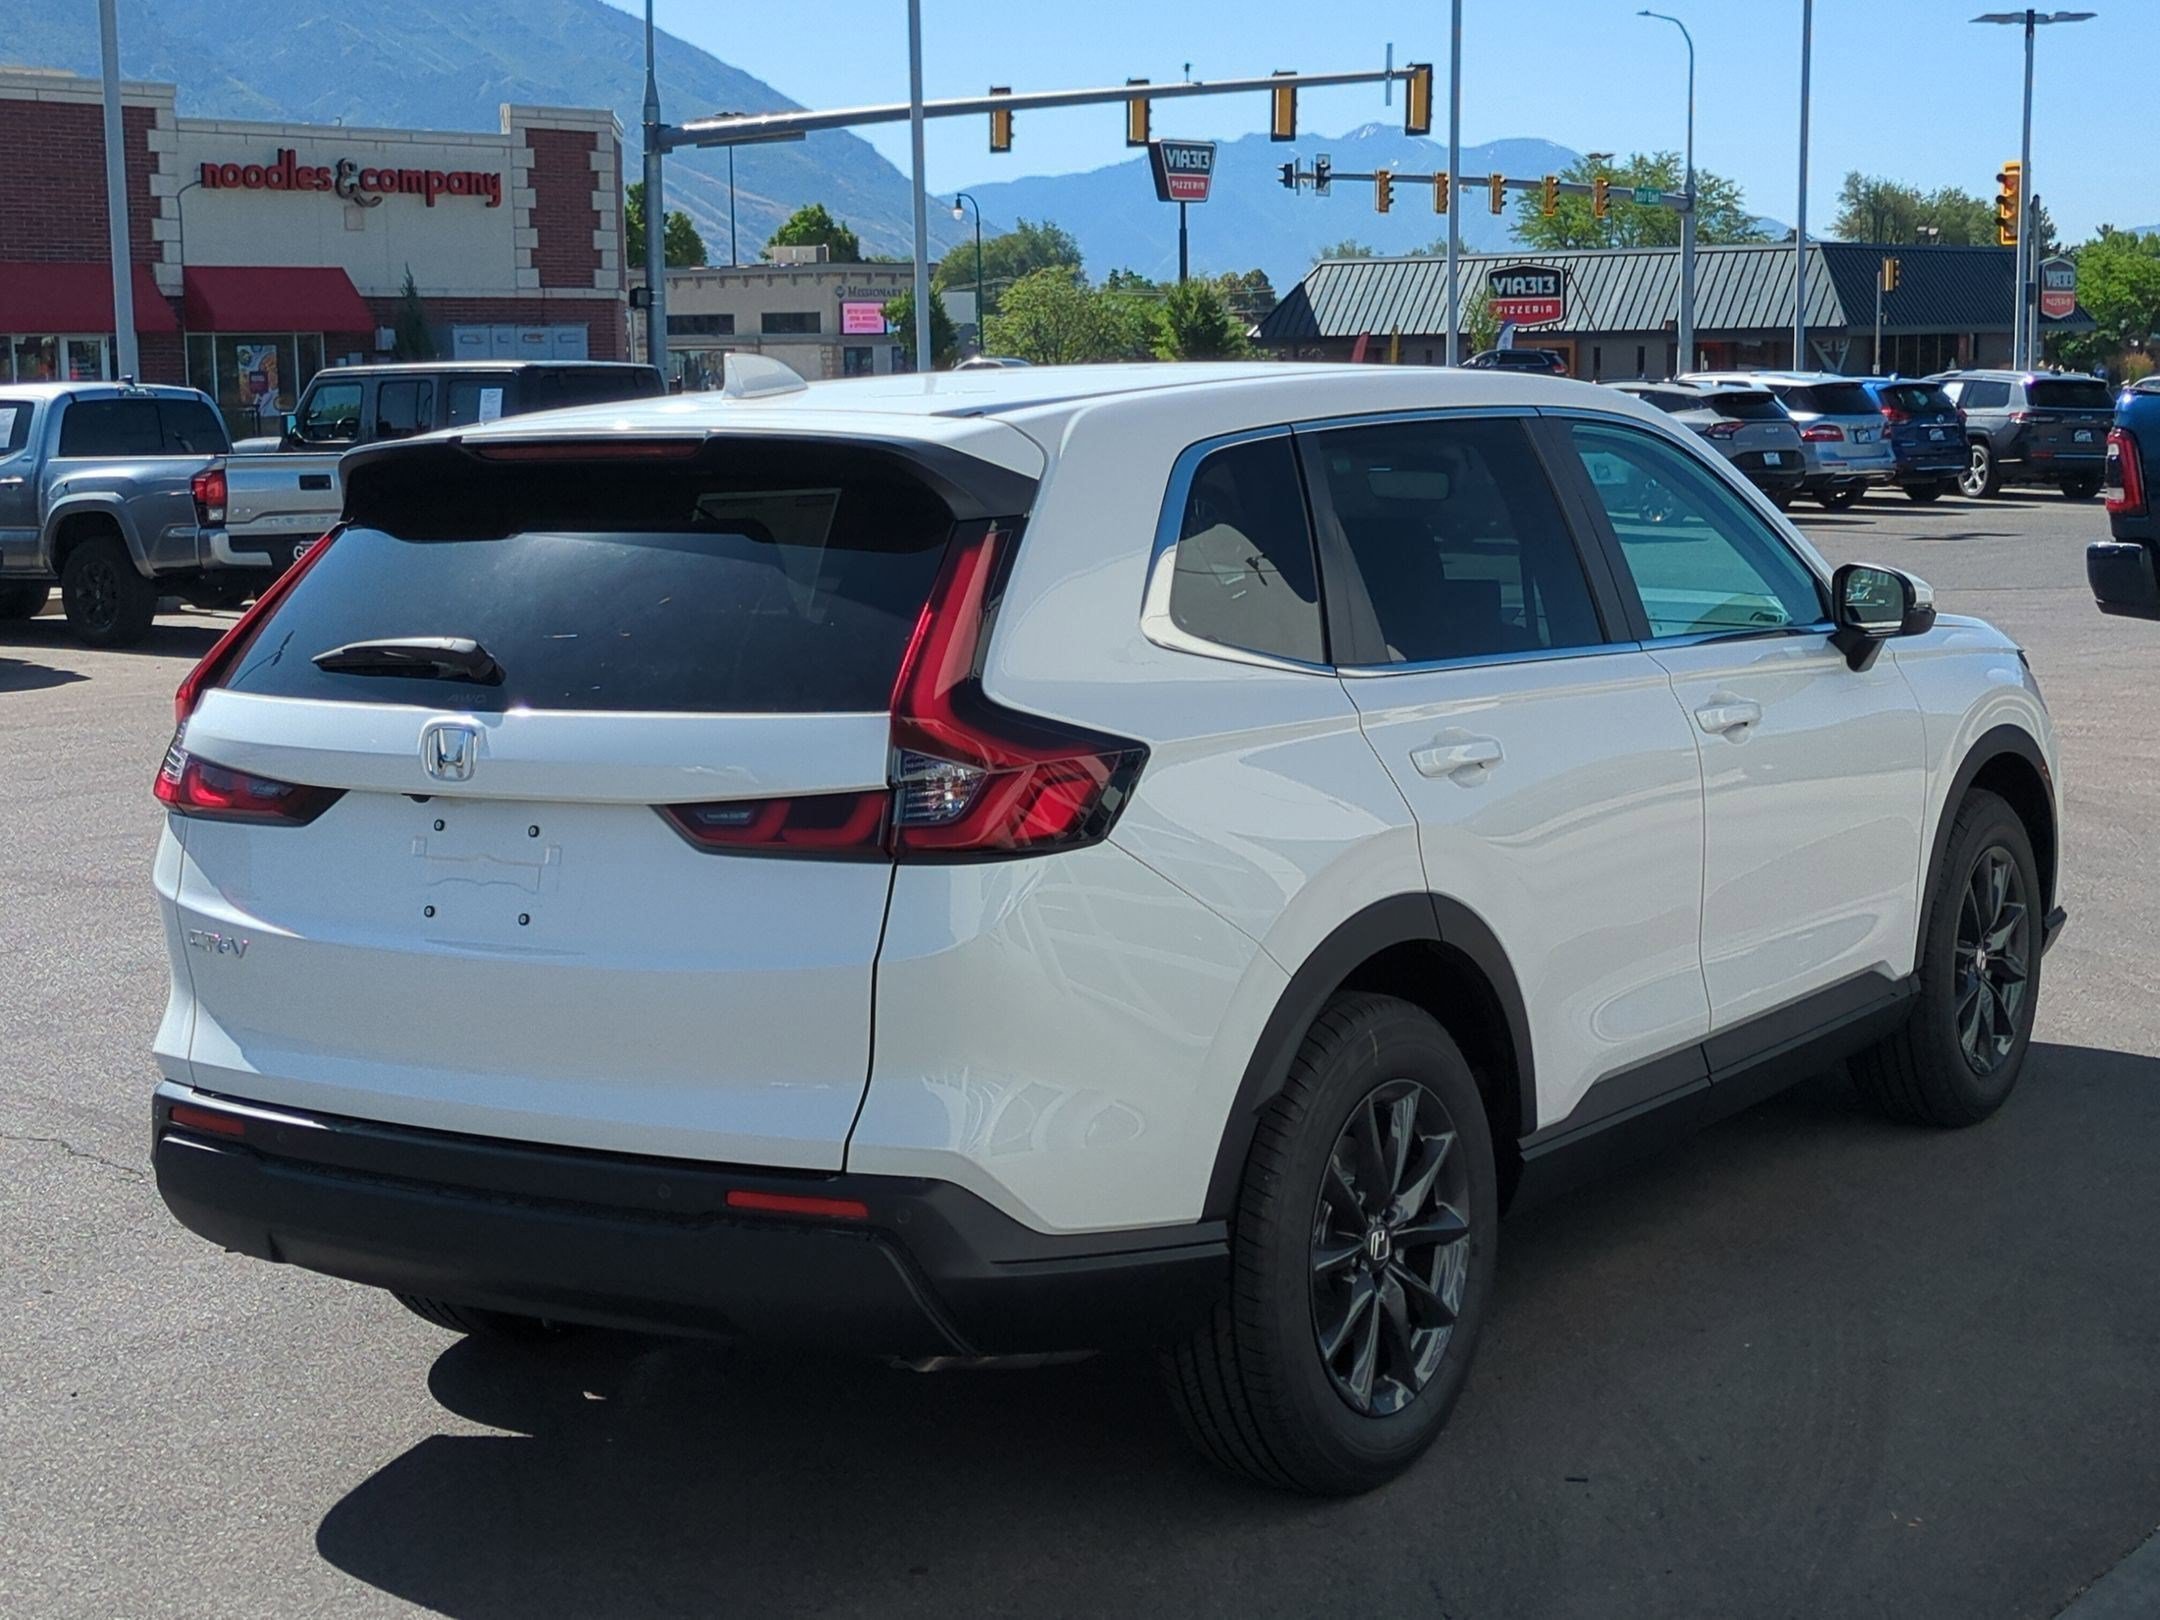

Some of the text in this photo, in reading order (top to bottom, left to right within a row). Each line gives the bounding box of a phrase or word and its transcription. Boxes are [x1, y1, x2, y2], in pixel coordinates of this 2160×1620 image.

[201, 148, 502, 208] noodles & company
[1492, 275, 1555, 295] VIA313
[1496, 305, 1553, 315] PIZZERIA
